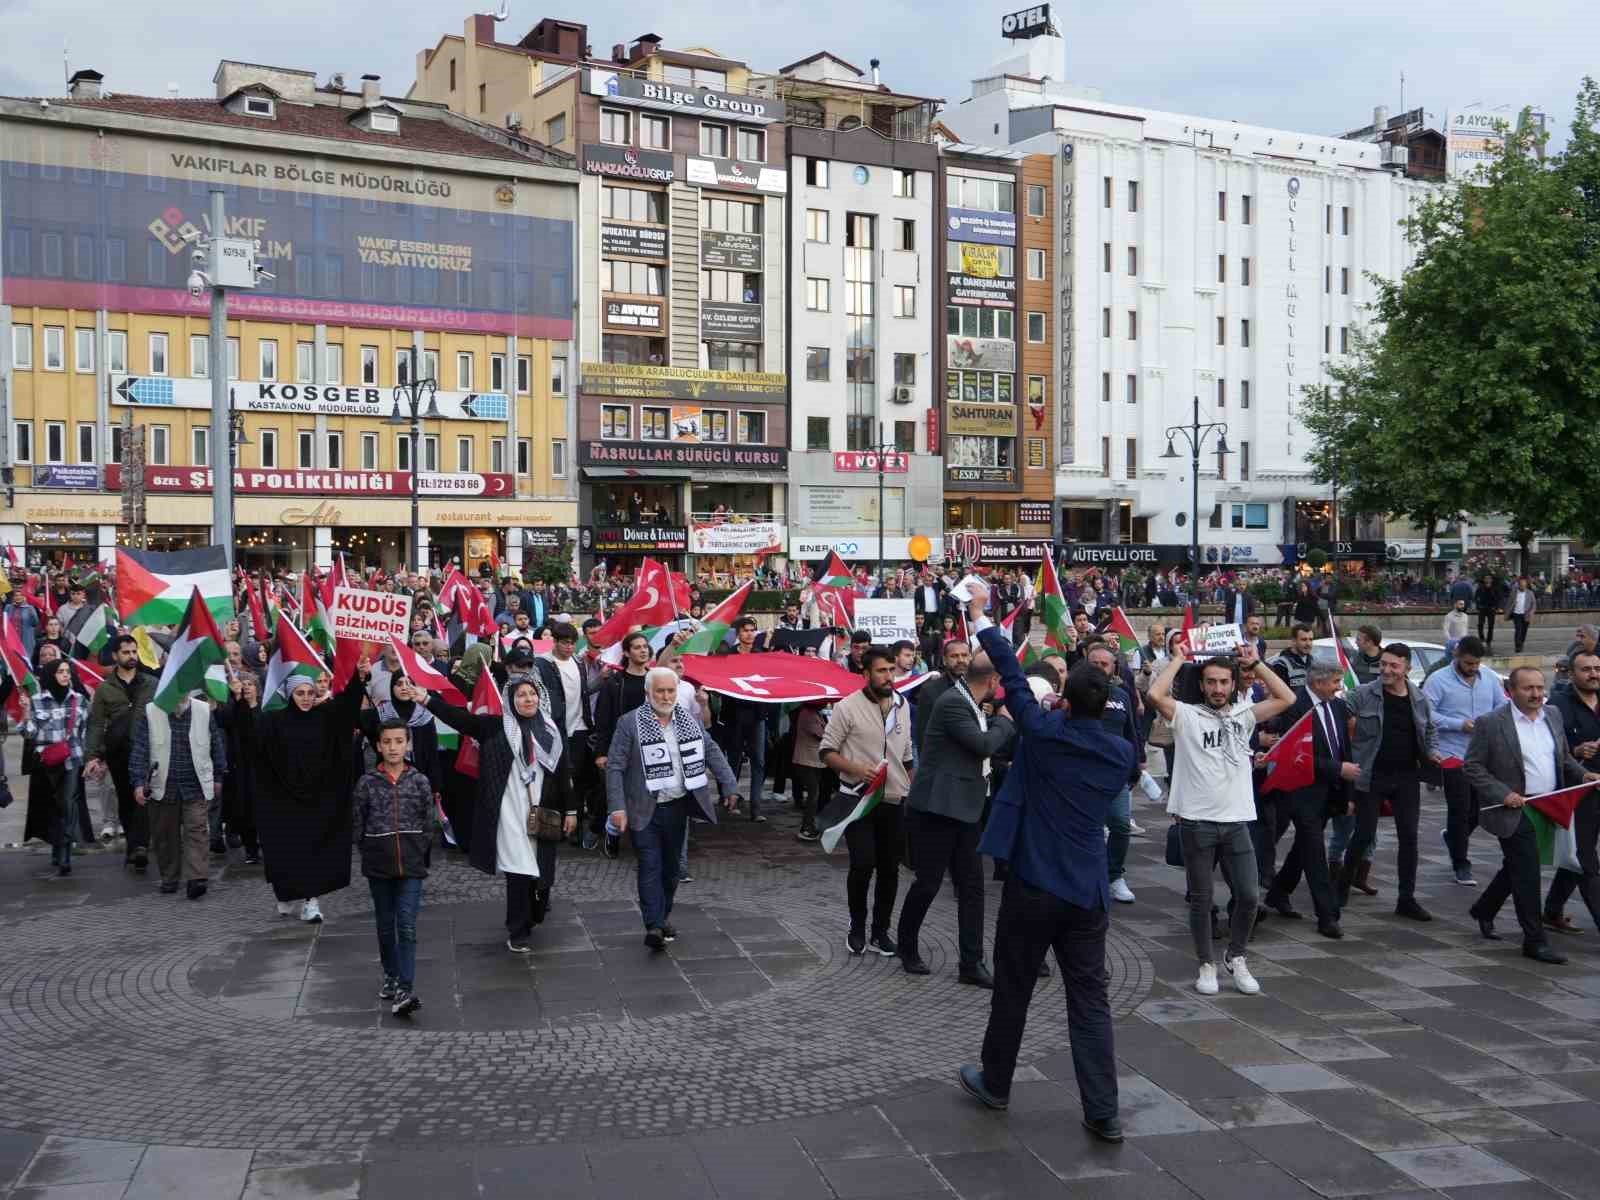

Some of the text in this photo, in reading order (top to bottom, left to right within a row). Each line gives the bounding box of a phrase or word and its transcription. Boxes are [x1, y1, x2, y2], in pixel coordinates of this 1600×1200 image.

[1003, 6, 1047, 33] OTEL
[643, 83, 765, 119] Bilge Group
[171, 153, 451, 198] VAKIFLAR BÖLGE MÜDÜRLÜĞÜ
[358, 236, 398, 251] VAKIF
[358, 248, 473, 272] YAŞATIYORUZ
[621, 303, 660, 317] AVUKAT
[259, 383, 380, 403] KOSGEB
[248, 401, 312, 411] KASTAMONU
[590, 447, 779, 463] NASRULLAH SÜRÜCÜ KURSU
[838, 454, 905, 468] 1. NOER
[153, 470, 393, 490] ÖZEL ŞİA POLİKLİNİĞİ
[436, 511, 492, 521] restaurant
[650, 528, 657, 541] &
[981, 544, 1008, 557] Döner
[1011, 545, 1018, 557] &
[1130, 549, 1158, 561] OTEL
[1231, 546, 1252, 557] QNB
[337, 593, 407, 618] KUDÜS
[335, 614, 404, 634] BİZİMDİR
[857, 615, 897, 626] #FREE
[866, 627, 916, 639] ALESTINE
